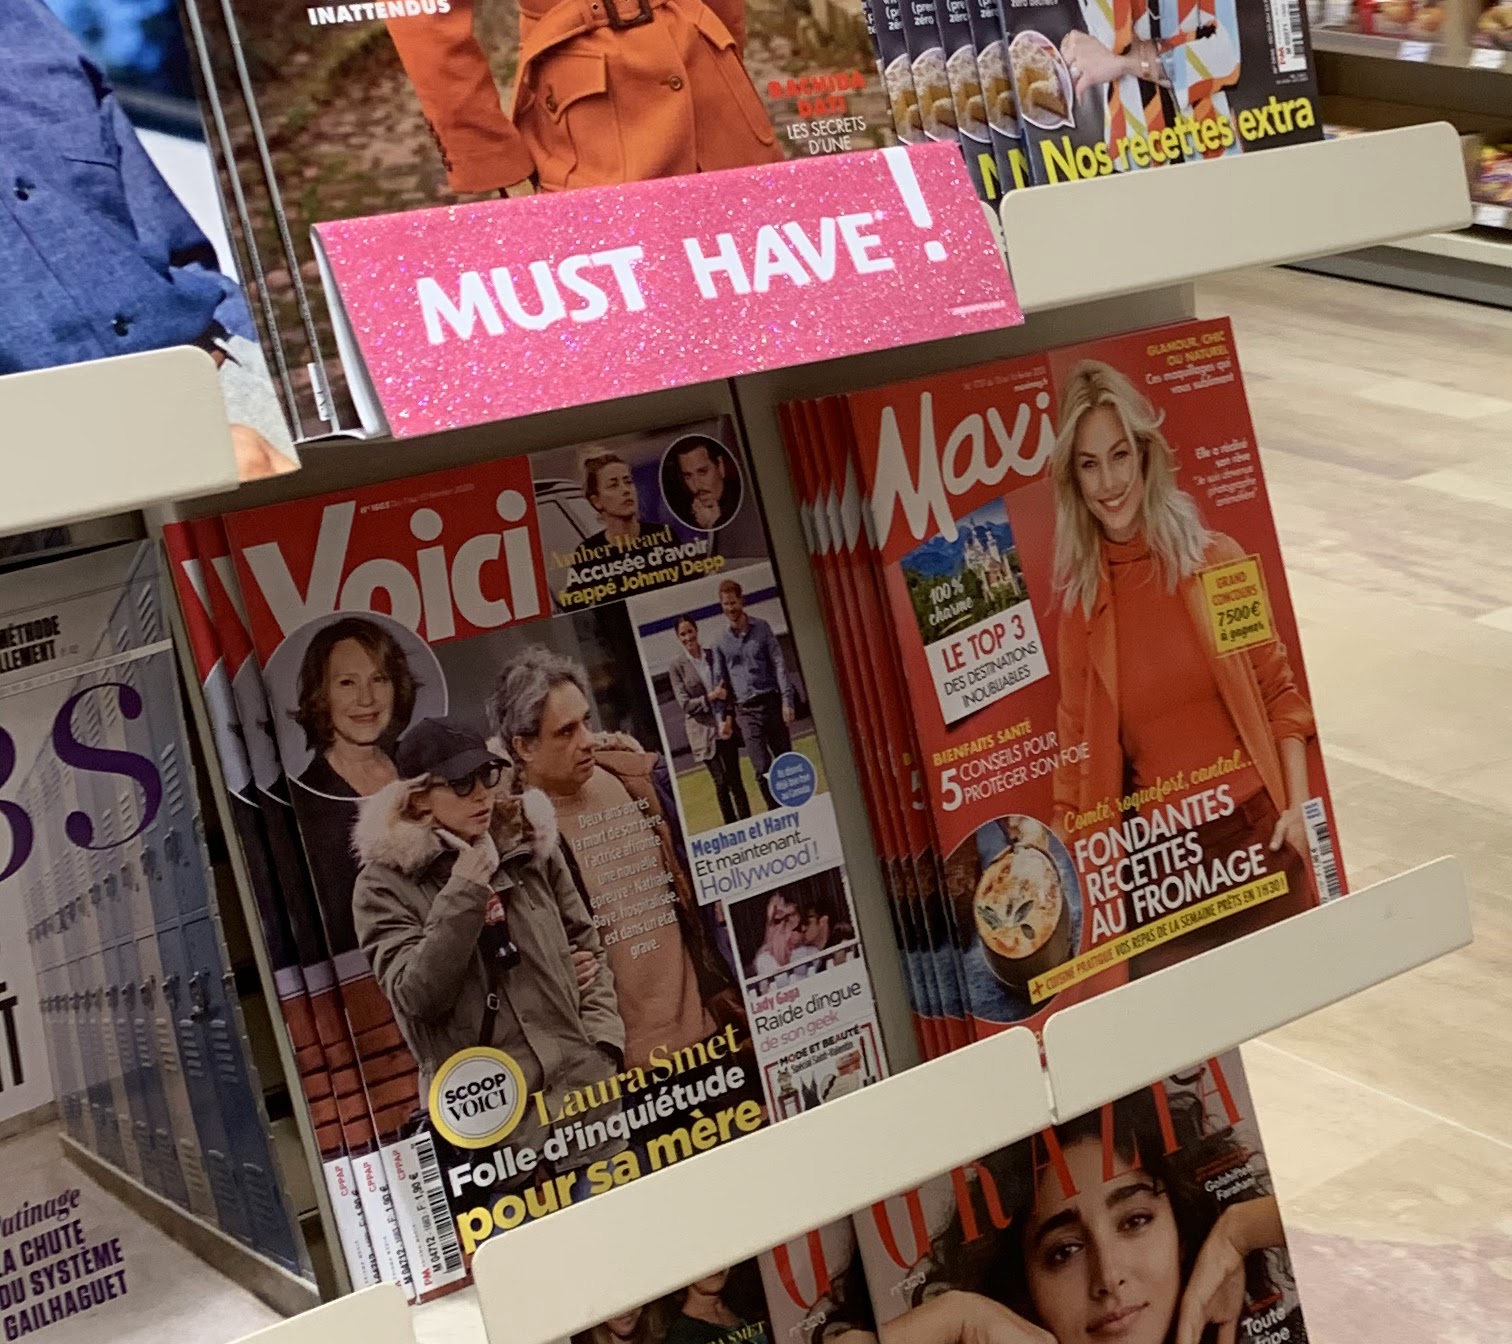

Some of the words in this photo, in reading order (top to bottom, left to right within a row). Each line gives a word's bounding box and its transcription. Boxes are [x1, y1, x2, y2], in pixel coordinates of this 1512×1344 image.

[786, 121, 810, 140] LES
[810, 115, 867, 138] SECRETS
[1040, 134, 1114, 184] Nos
[1116, 112, 1233, 171] recettes
[1237, 95, 1316, 142] extra
[414, 242, 645, 346] MUST
[681, 209, 884, 304] HAVE
[884, 145, 950, 264] !
[870, 390, 1056, 553] Maxi
[241, 487, 542, 645] Voici
[565, 552, 646, 587] Accusée
[648, 536, 709, 566] d'avoir
[620, 564, 680, 593] Johnny
[681, 554, 726, 576] Depp
[941, 641, 967, 674] LE
[966, 622, 1006, 661] TOP
[1010, 614, 1026, 641] 3
[943, 675, 967, 696] DES
[966, 640, 1038, 686] DESTINATIONS
[961, 663, 1032, 709] INOUBLIABLES
[931, 735, 995, 769] BIENFAITS
[995, 716, 1033, 748] SANTÉ
[959, 742, 1024, 783] CONSEILS
[1024, 730, 1060, 760] POUR
[939, 767, 965, 813] 5
[691, 829, 747, 859] Meghan
[748, 823, 763, 840] et
[764, 810, 800, 838] Harry
[1073, 784, 1237, 874] FONDANTES
[699, 845, 812, 900] Hollywood
[1084, 831, 1205, 907] RECETTES
[1090, 895, 1129, 944] AU
[1131, 843, 1269, 925] FROMAGE
[754, 1005, 804, 1035] Raide
[805, 982, 862, 1014] dingue
[444, 1070, 509, 1106] SCOOP
[530, 1066, 651, 1130] Laura
[649, 1022, 743, 1086] Smet
[446, 1090, 509, 1124] VOICI
[447, 1140, 539, 1199] Folle
[541, 1062, 746, 1163] d'inquiétude
[391, 1149, 407, 1182] CPPAP
[455, 1167, 579, 1255] pour
[584, 1146, 642, 1197] sa
[646, 1098, 763, 1168] mère
[20, 1218, 86, 1267] CHUTE
[3, 1268, 129, 1343] GAILHAGUET
[1241, 1306, 1288, 1337] Toute
